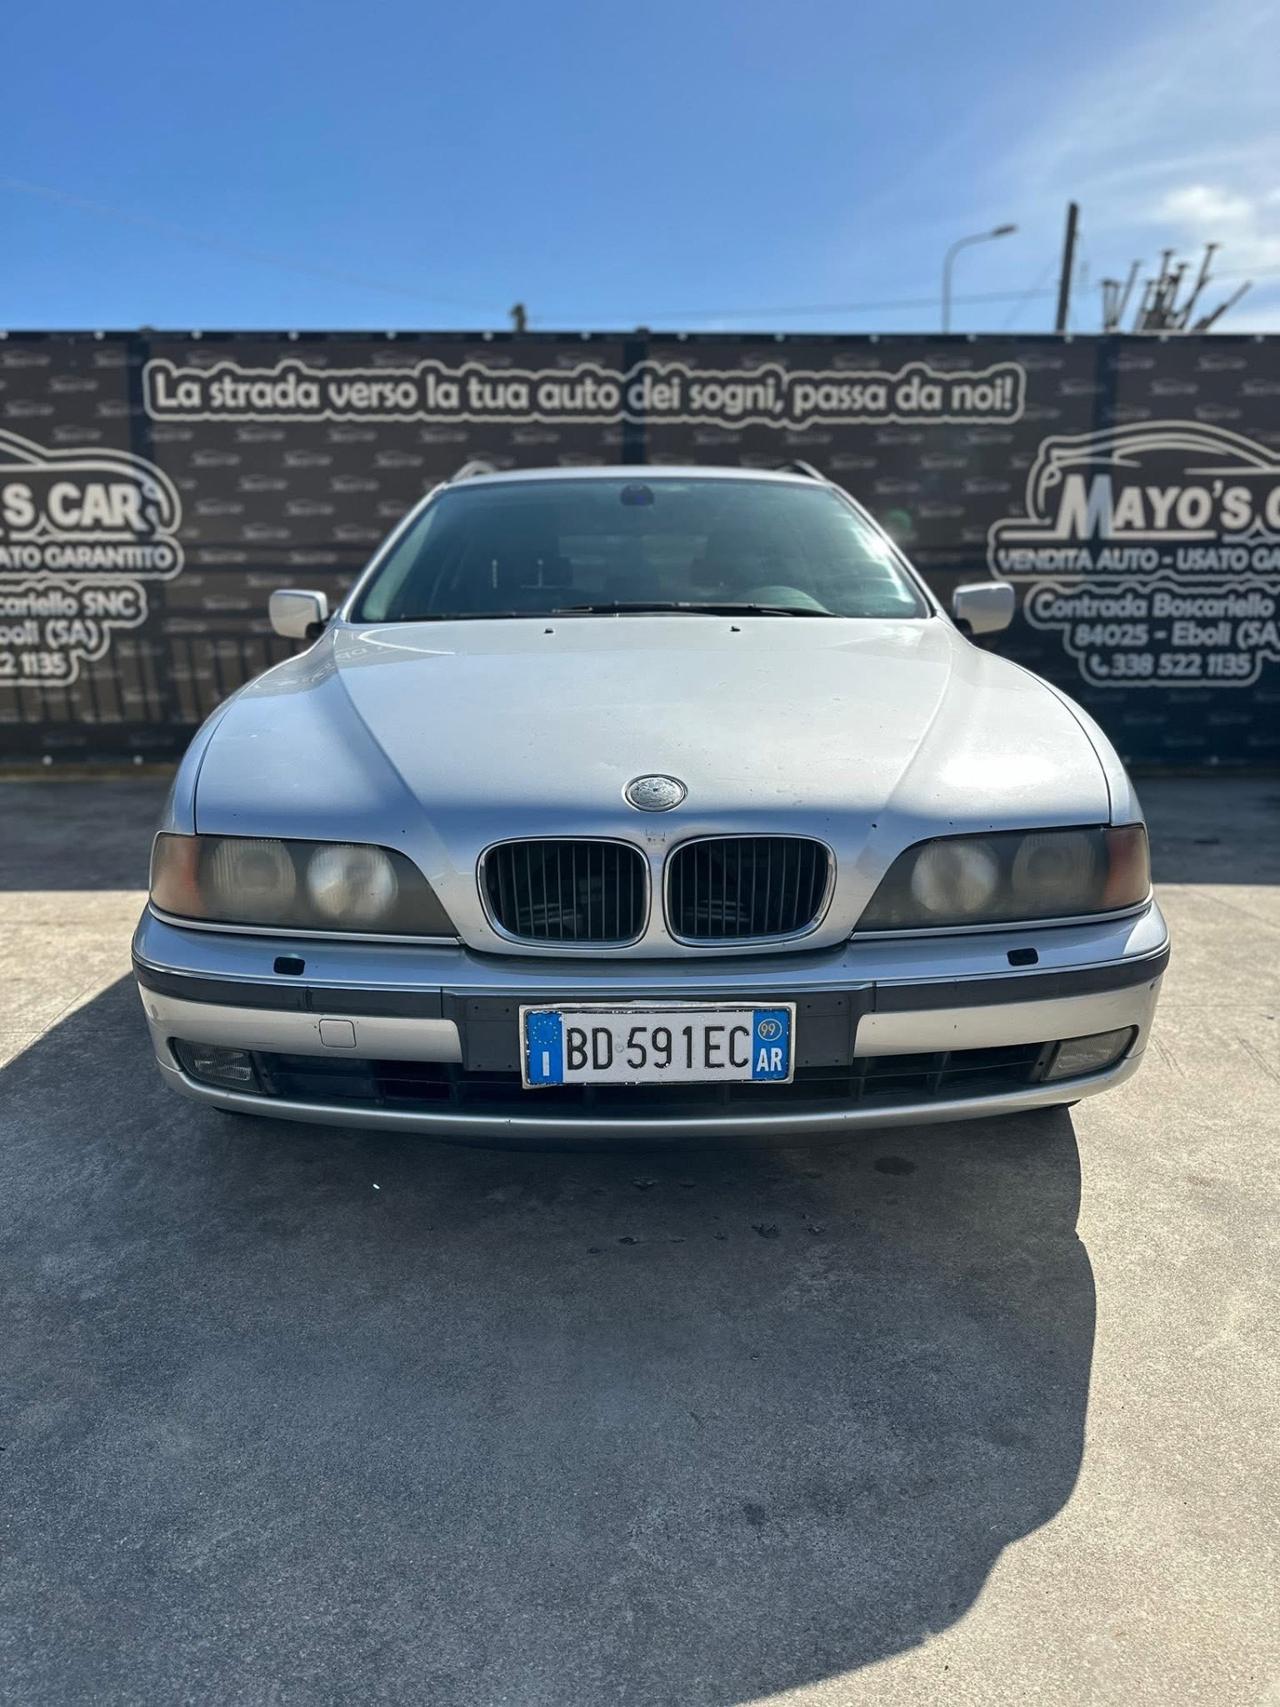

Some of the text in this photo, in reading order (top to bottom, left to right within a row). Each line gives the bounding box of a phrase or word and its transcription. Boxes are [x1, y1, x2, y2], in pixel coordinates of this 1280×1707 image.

[156, 373, 1012, 417] La strada verso la tua auto dei sogni, passa da noi!
[48, 483, 151, 531] CAR
[1055, 474, 1253, 540] MAYO'S
[43, 545, 173, 569] GARANTITO
[999, 548, 1093, 570] VENDITA
[1096, 548, 1159, 570] AUTO
[1176, 548, 1250, 571] USATO
[82, 591, 136, 616] SNC
[1035, 592, 1276, 618] Contrada Boscariello
[45, 619, 98, 650] (SA)
[1074, 623, 1149, 647] 84025
[1171, 621, 1232, 646] Eboli
[21, 652, 67, 675] 1135
[1157, 653, 1201, 676] 522
[1207, 653, 1251, 676] 1135
[760, 1023, 776, 1037] 99
[756, 1047, 782, 1072] AR
